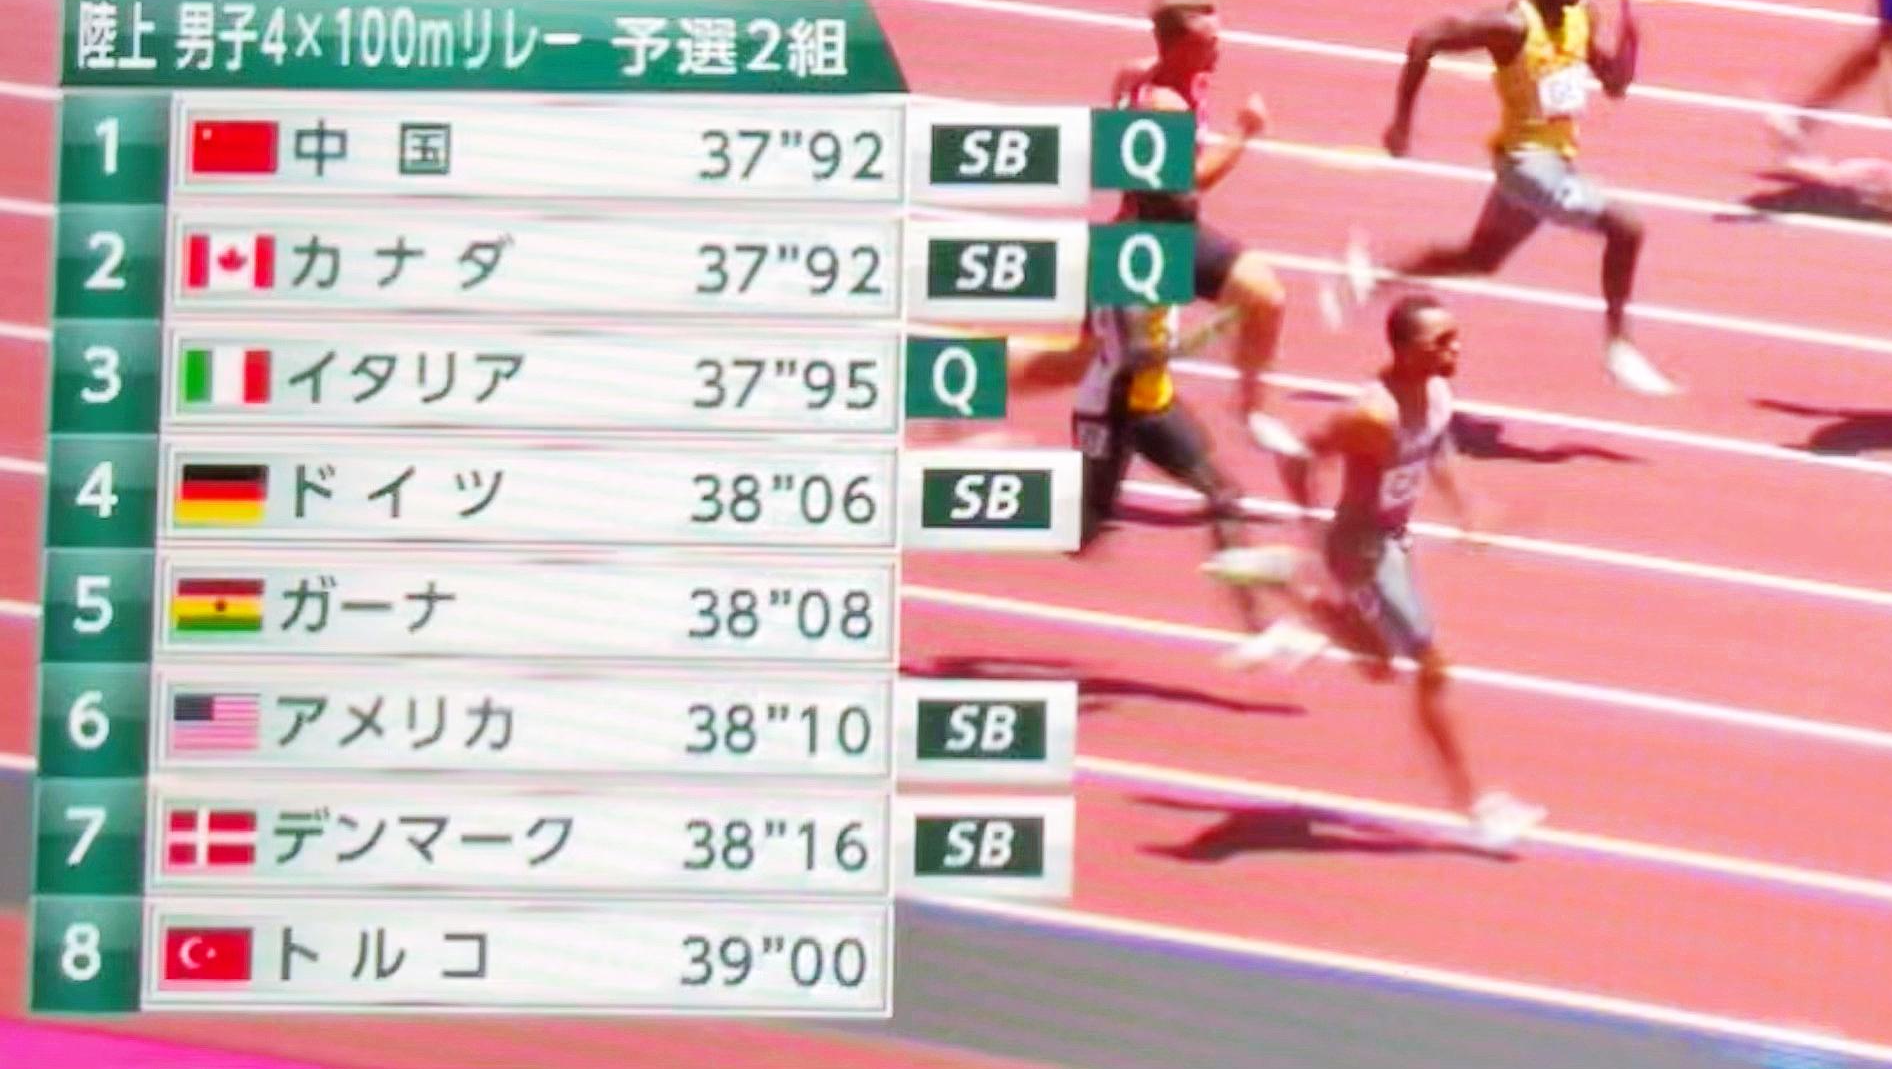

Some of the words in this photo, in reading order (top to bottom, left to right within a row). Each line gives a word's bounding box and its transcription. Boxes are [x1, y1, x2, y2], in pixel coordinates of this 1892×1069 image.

[76, 1, 157, 72] 陸上
[612, 15, 849, 80] 予選2組
[95, 119, 120, 174] 1
[957, 130, 1031, 177] SB
[1121, 118, 1167, 190] Q
[84, 235, 125, 288] 2
[291, 235, 515, 290] カナダ
[955, 245, 1028, 291] SB
[1118, 237, 1161, 303] Q
[81, 348, 122, 404] 3
[286, 352, 524, 404] イタリア
[933, 353, 978, 418] Q
[75, 463, 119, 516] 4
[290, 466, 506, 513] ドイツ
[949, 475, 1023, 521] SB
[74, 578, 113, 633] 5
[279, 581, 457, 633] ガーナ
[68, 693, 108, 747] 6
[275, 696, 515, 750] アメリカ
[944, 704, 1017, 751] SB
[65, 811, 107, 864] 7
[271, 814, 574, 866] デンマーク
[941, 821, 1014, 866] SB
[61, 924, 102, 979] 8
[280, 931, 488, 982] トルコ
